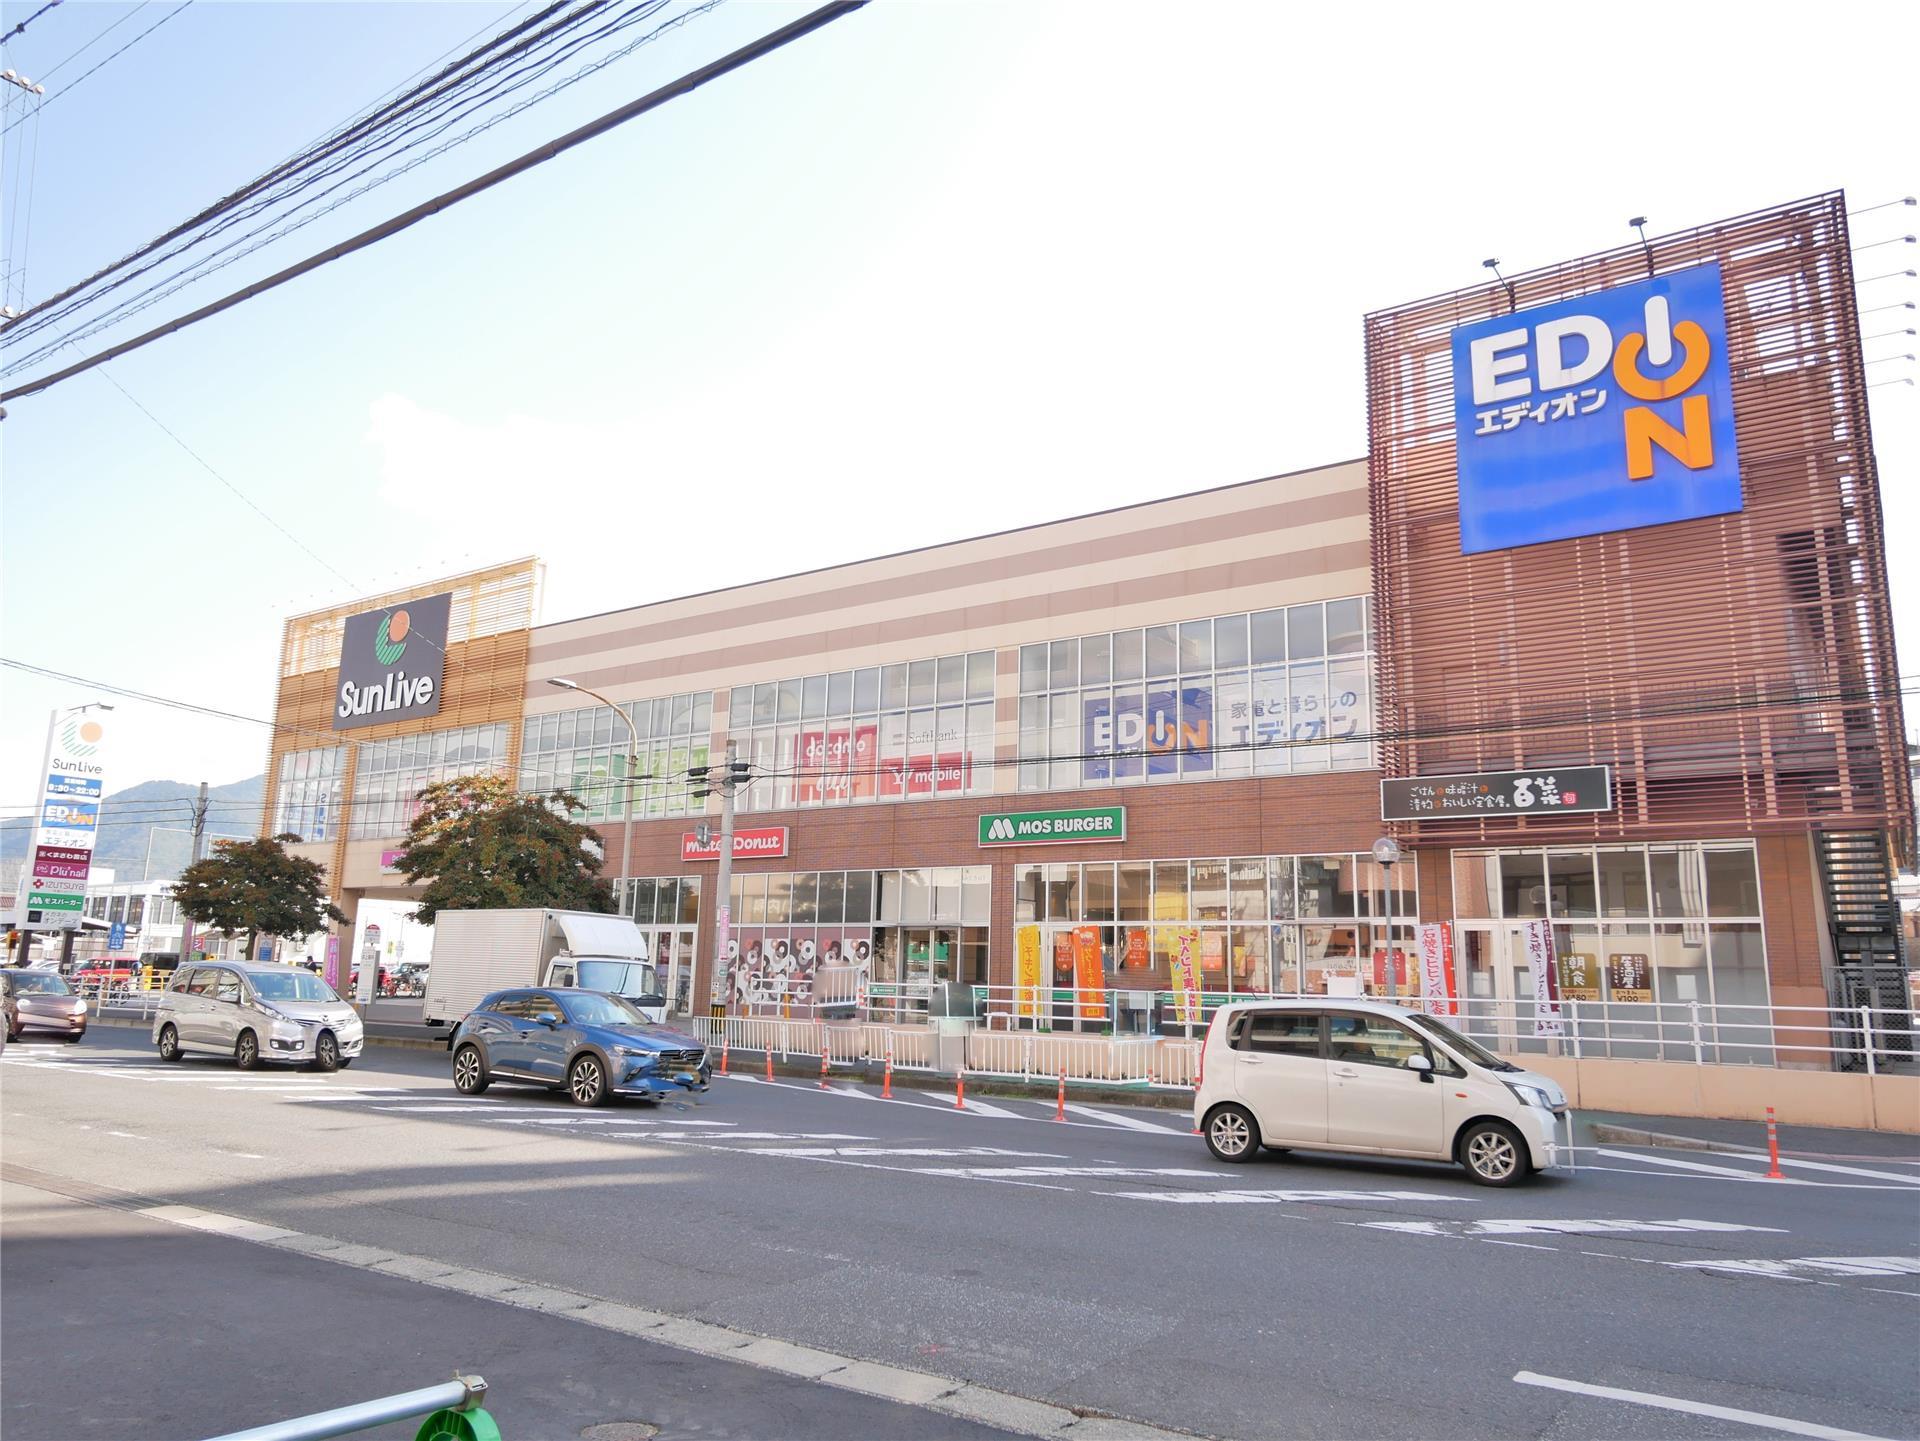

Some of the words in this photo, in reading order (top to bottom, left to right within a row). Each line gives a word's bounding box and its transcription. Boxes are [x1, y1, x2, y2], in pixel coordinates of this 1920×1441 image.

[1470, 295, 1714, 482] EDION
[1474, 388, 1607, 436] エディオン
[338, 671, 434, 718] SunLive
[1230, 691, 1357, 720] 家電と暮らしの
[1094, 710, 1209, 755] EDION
[1232, 716, 1358, 745] エディオン
[52, 758, 103, 774] SunLive
[1411, 785, 1435, 797] ごはん
[1018, 819, 1051, 834] MOS
[1054, 816, 1113, 833] BURGER
[733, 835, 781, 851] Donut
[1568, 955, 1586, 986] 朝食
[1620, 955, 1636, 989] 居酒屋
